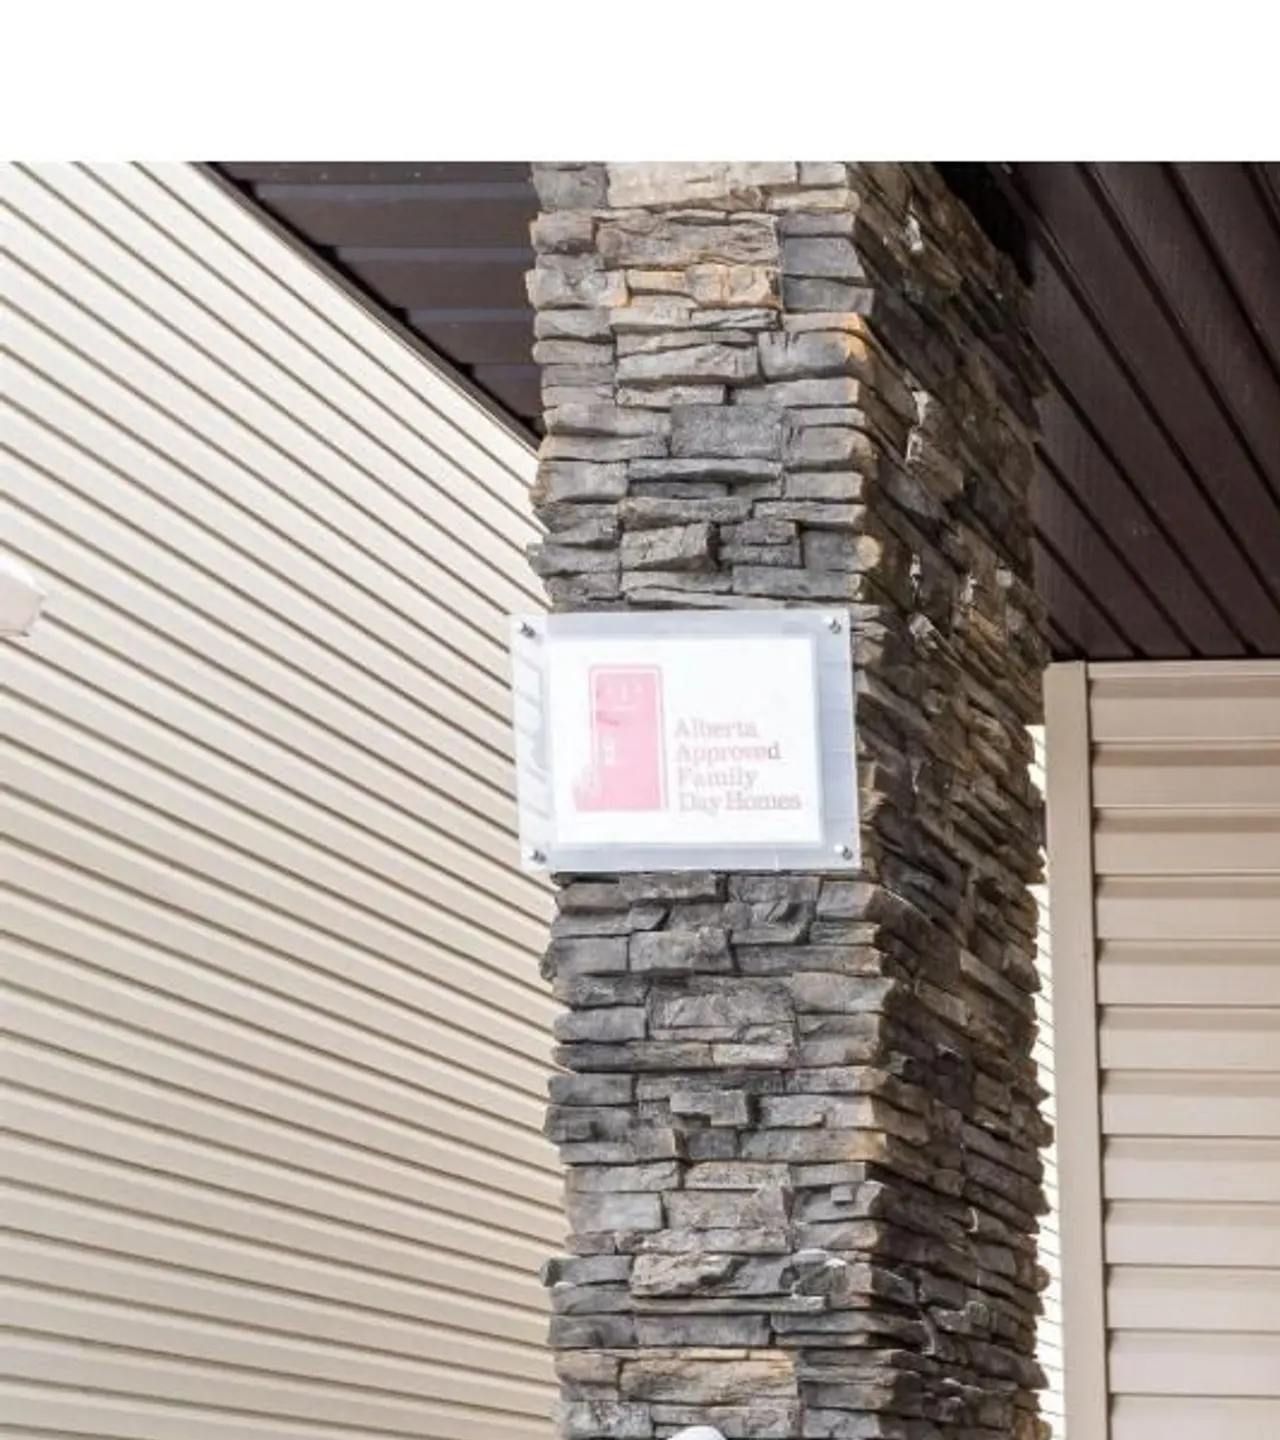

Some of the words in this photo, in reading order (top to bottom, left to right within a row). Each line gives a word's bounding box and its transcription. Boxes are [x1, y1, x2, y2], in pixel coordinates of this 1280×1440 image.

[675, 718, 758, 739] Alberta
[676, 741, 781, 767] Approved
[678, 767, 759, 792] Family
[680, 791, 722, 817] Day
[727, 791, 802, 811] Homes
